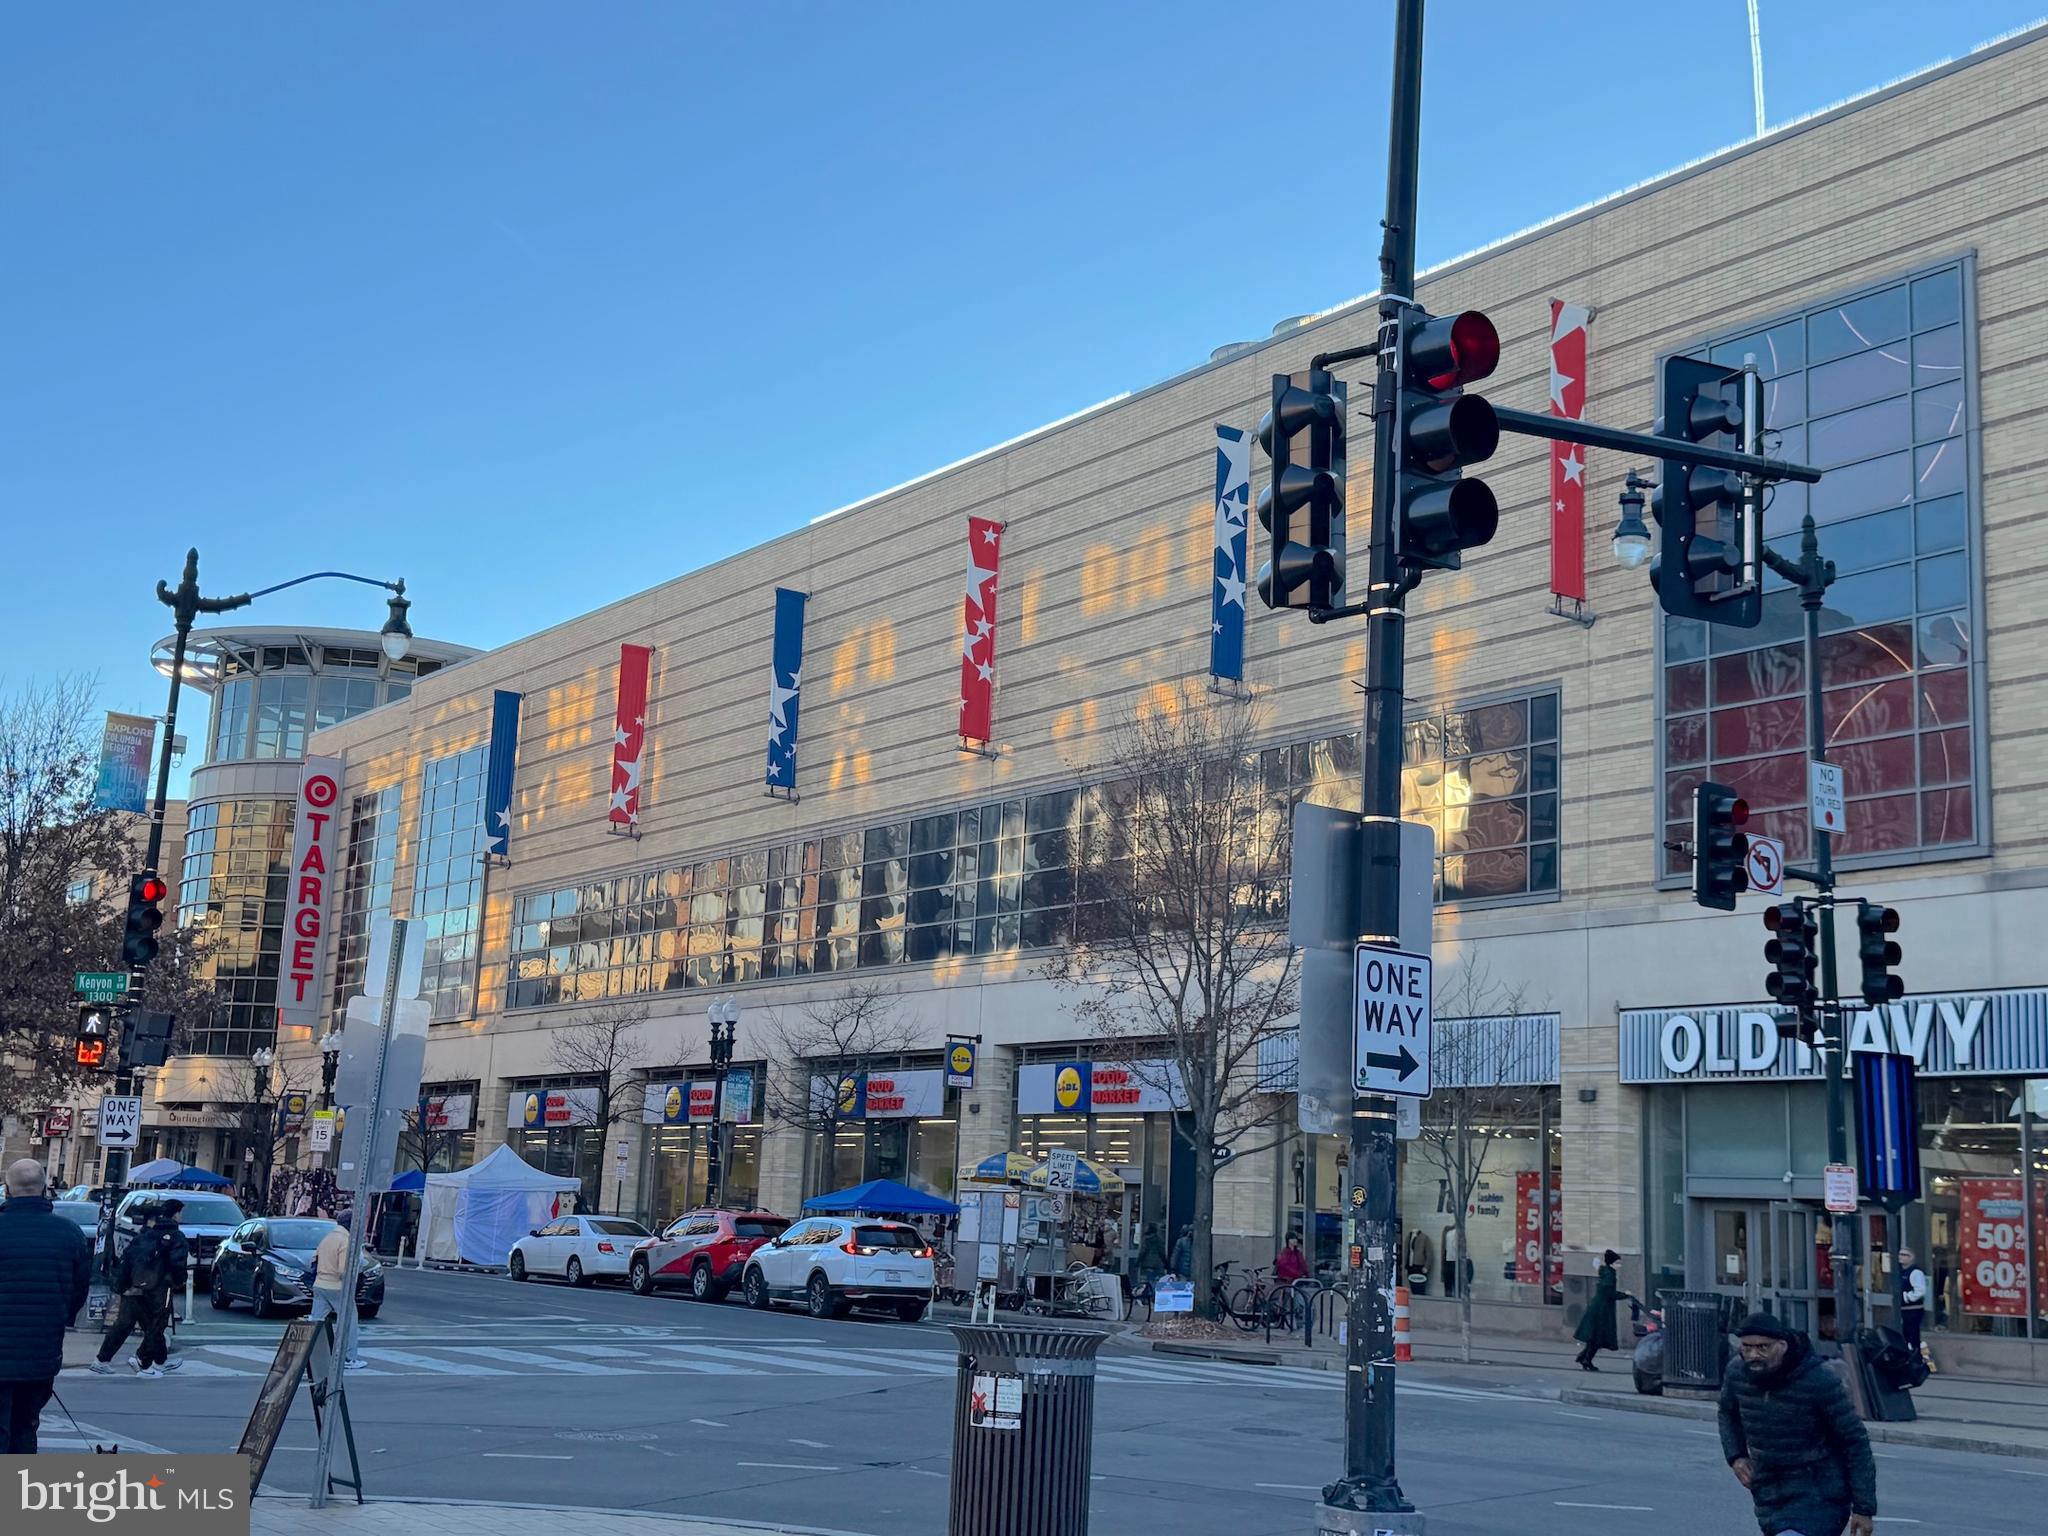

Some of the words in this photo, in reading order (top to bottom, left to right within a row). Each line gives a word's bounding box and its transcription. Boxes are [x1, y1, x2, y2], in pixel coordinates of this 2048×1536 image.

[107, 722, 153, 737] EXPLORE
[105, 732, 142, 746] COLUMBIA
[104, 742, 136, 754] HEIGHTS
[1820, 768, 1834, 781] NO
[1819, 783, 1837, 795] TURN
[1815, 796, 1826, 807] ON
[1828, 799, 1841, 810] RED
[290, 812, 330, 1002] TARGET
[79, 975, 112, 991] Kenyon
[1366, 960, 1422, 998] ONE
[90, 992, 112, 1002] 1300
[1364, 999, 1423, 1038] WAY
[1660, 1012, 1779, 1074] OLD
[1092, 1071, 1127, 1084] FOOD
[1092, 1089, 1141, 1103] MARKET
[107, 1100, 136, 1112] ONE
[106, 1114, 136, 1126] WAY
[316, 1130, 328, 1140] 15
[1052, 1152, 1075, 1161] SPEED
[1477, 1205, 1500, 1218] family
[1990, 1288, 2020, 1299] Deals
